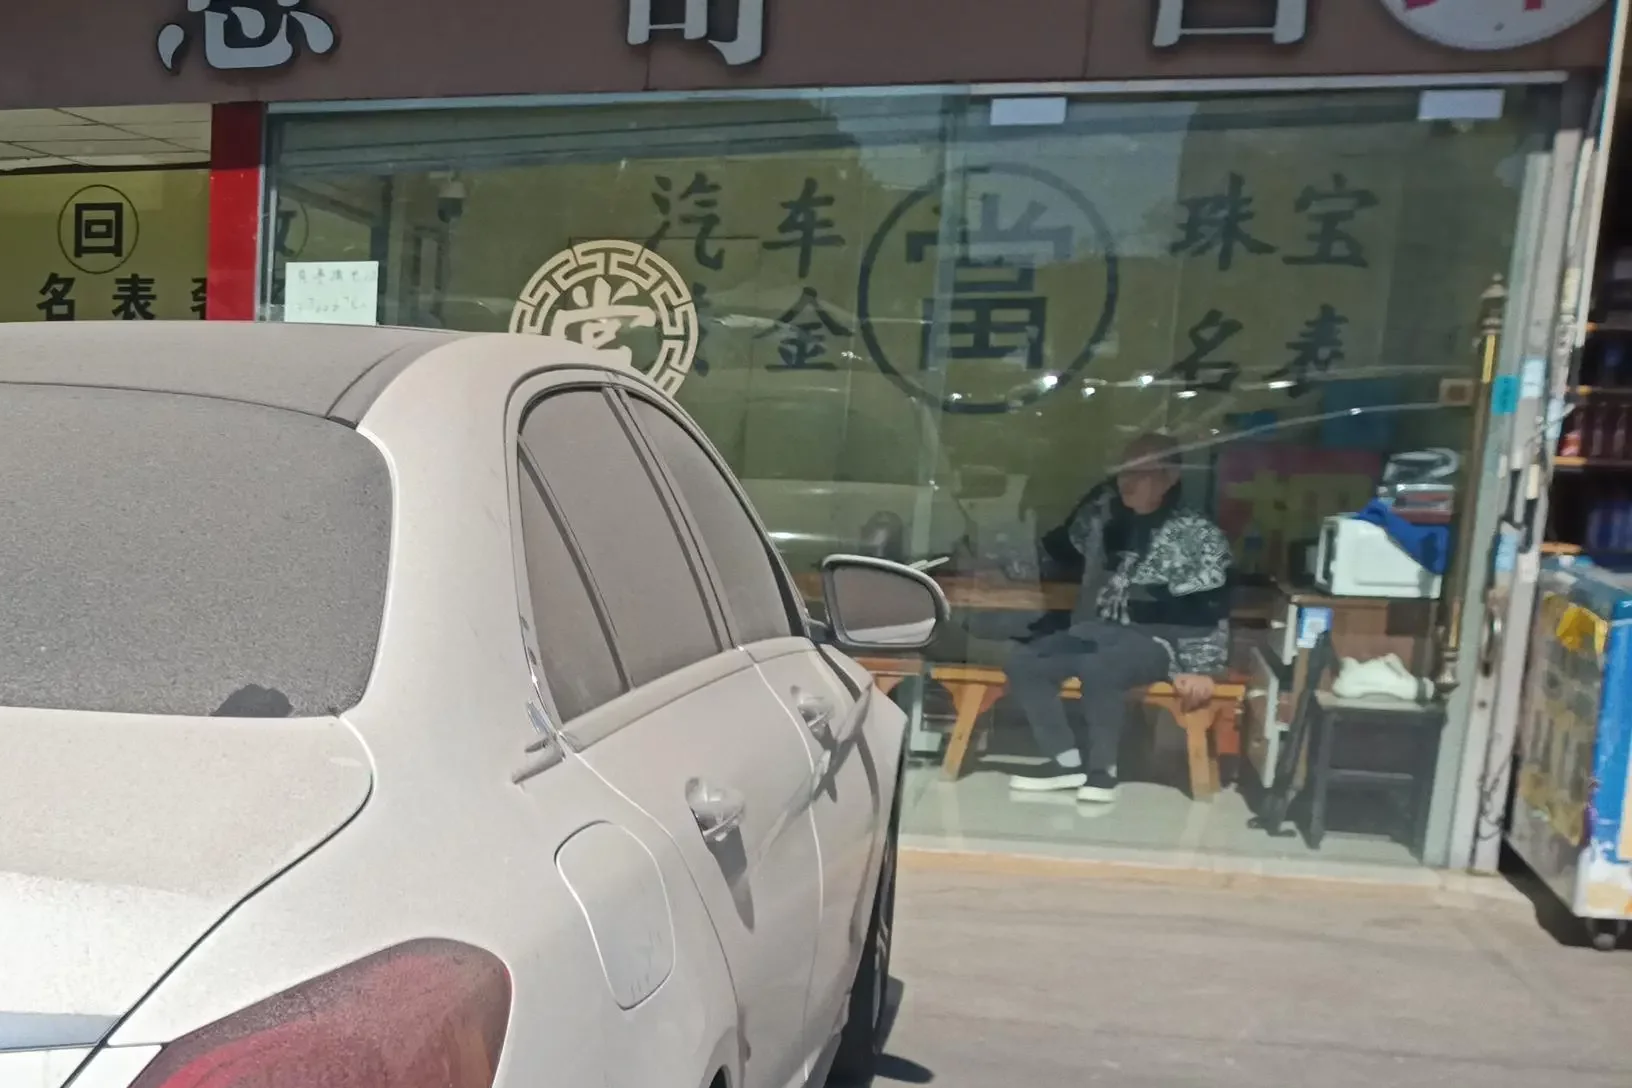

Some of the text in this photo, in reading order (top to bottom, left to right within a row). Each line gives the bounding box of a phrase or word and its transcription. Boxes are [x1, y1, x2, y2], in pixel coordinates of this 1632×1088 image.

[644, 171, 846, 280] 汽车
[1169, 171, 1381, 272] 珠宝
[36, 272, 156, 321] 名表
